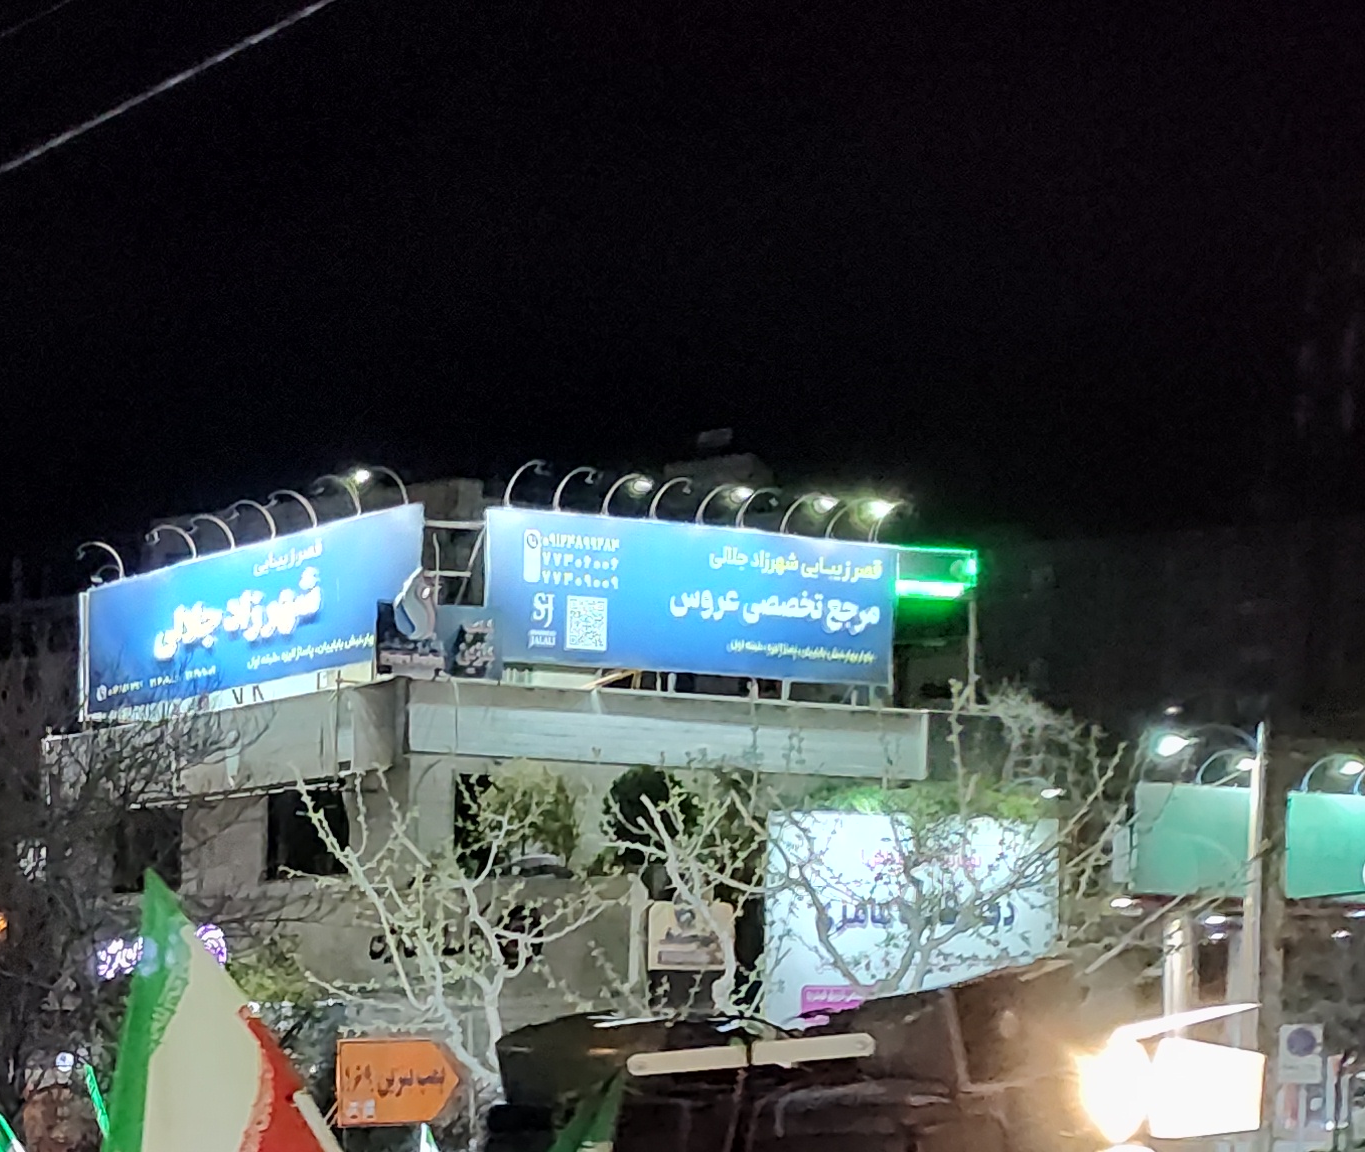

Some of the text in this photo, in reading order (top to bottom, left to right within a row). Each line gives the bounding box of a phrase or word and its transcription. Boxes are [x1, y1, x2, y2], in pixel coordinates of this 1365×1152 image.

[253, 537, 323, 577] قصر زیبایی
[709, 546, 748, 571] جلالی
[750, 550, 799, 575] شهرزاد
[853, 559, 882, 583] قصر
[154, 566, 322, 660] شهرزاد جلالی
[669, 590, 880, 635] مرجع تخصصی عروس
